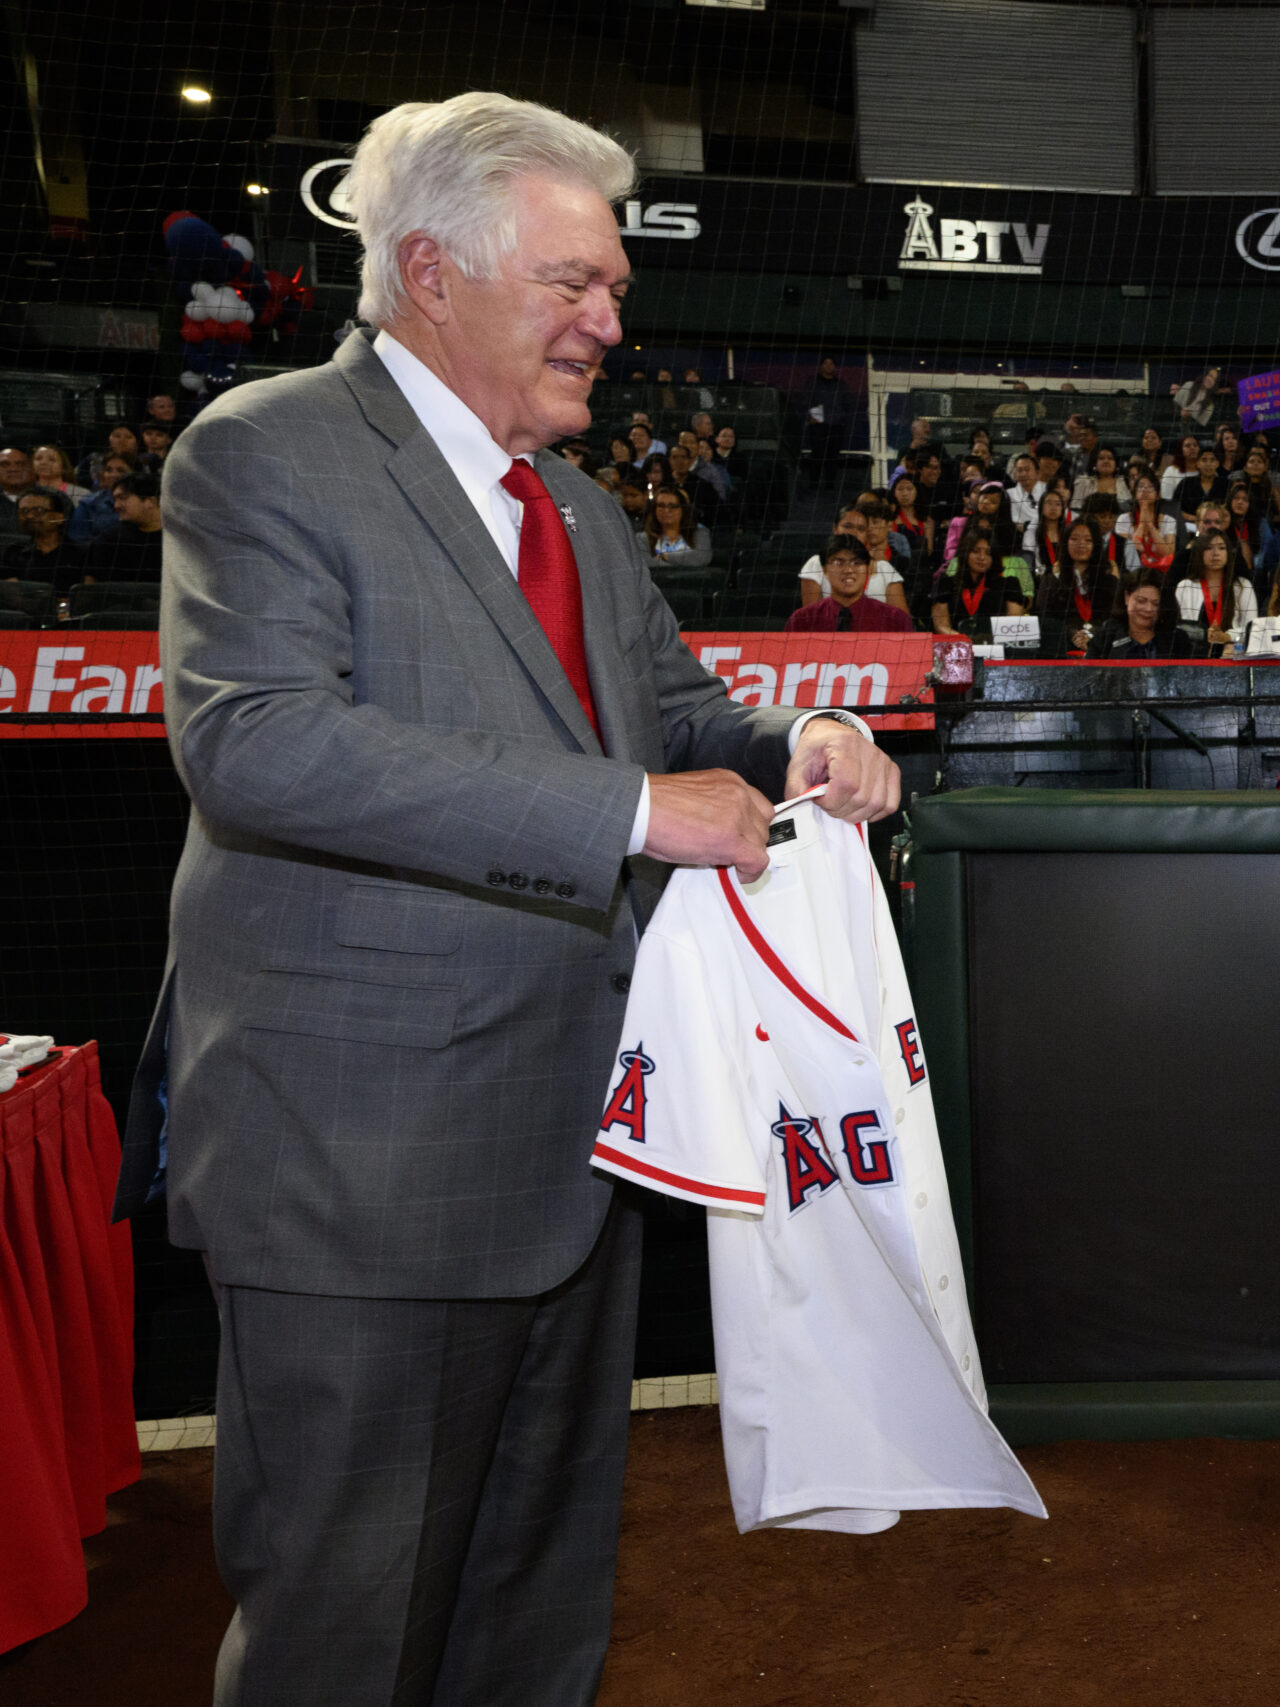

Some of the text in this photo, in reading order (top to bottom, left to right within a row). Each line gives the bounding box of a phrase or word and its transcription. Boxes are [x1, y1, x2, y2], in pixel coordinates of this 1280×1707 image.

[899, 193, 1052, 264] ABTV
[1000, 623, 1031, 634] OCDE
[28, 646, 164, 713] Far
[700, 646, 889, 713] Farm
